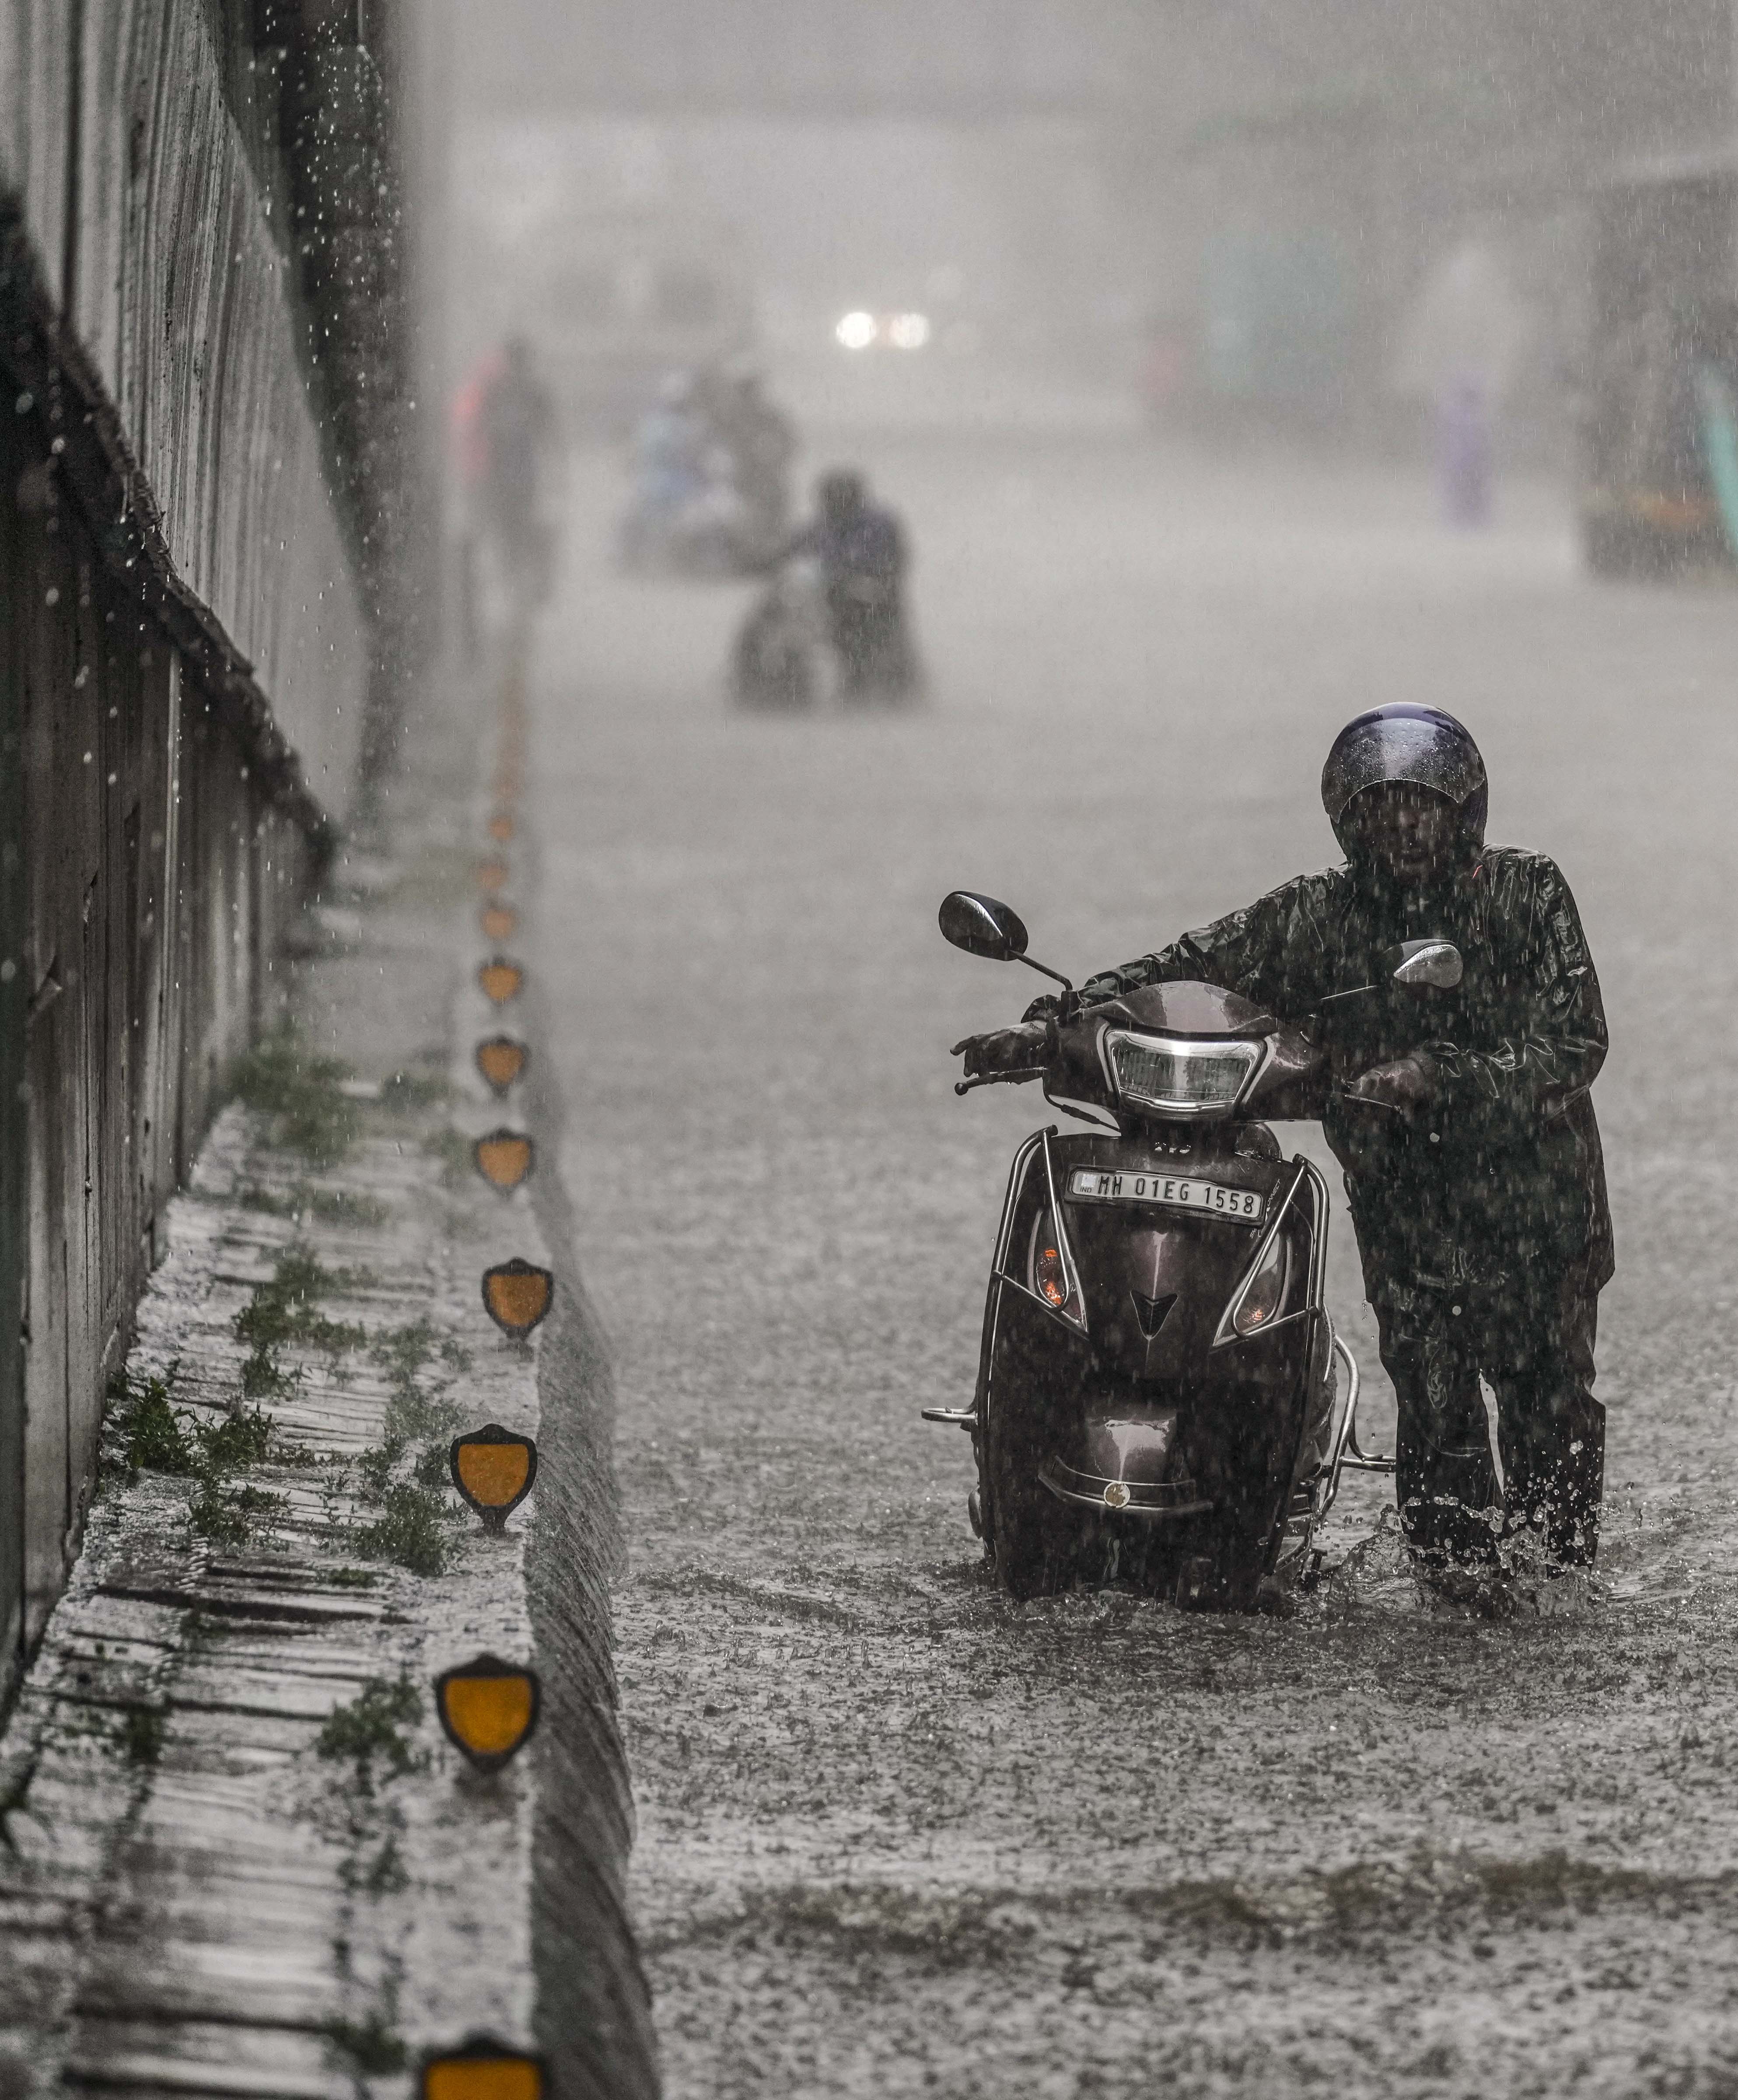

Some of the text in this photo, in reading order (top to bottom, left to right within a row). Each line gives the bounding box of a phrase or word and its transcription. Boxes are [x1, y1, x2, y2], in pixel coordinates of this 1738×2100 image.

[1098, 1175, 1254, 1213] MH 01EG 1558
